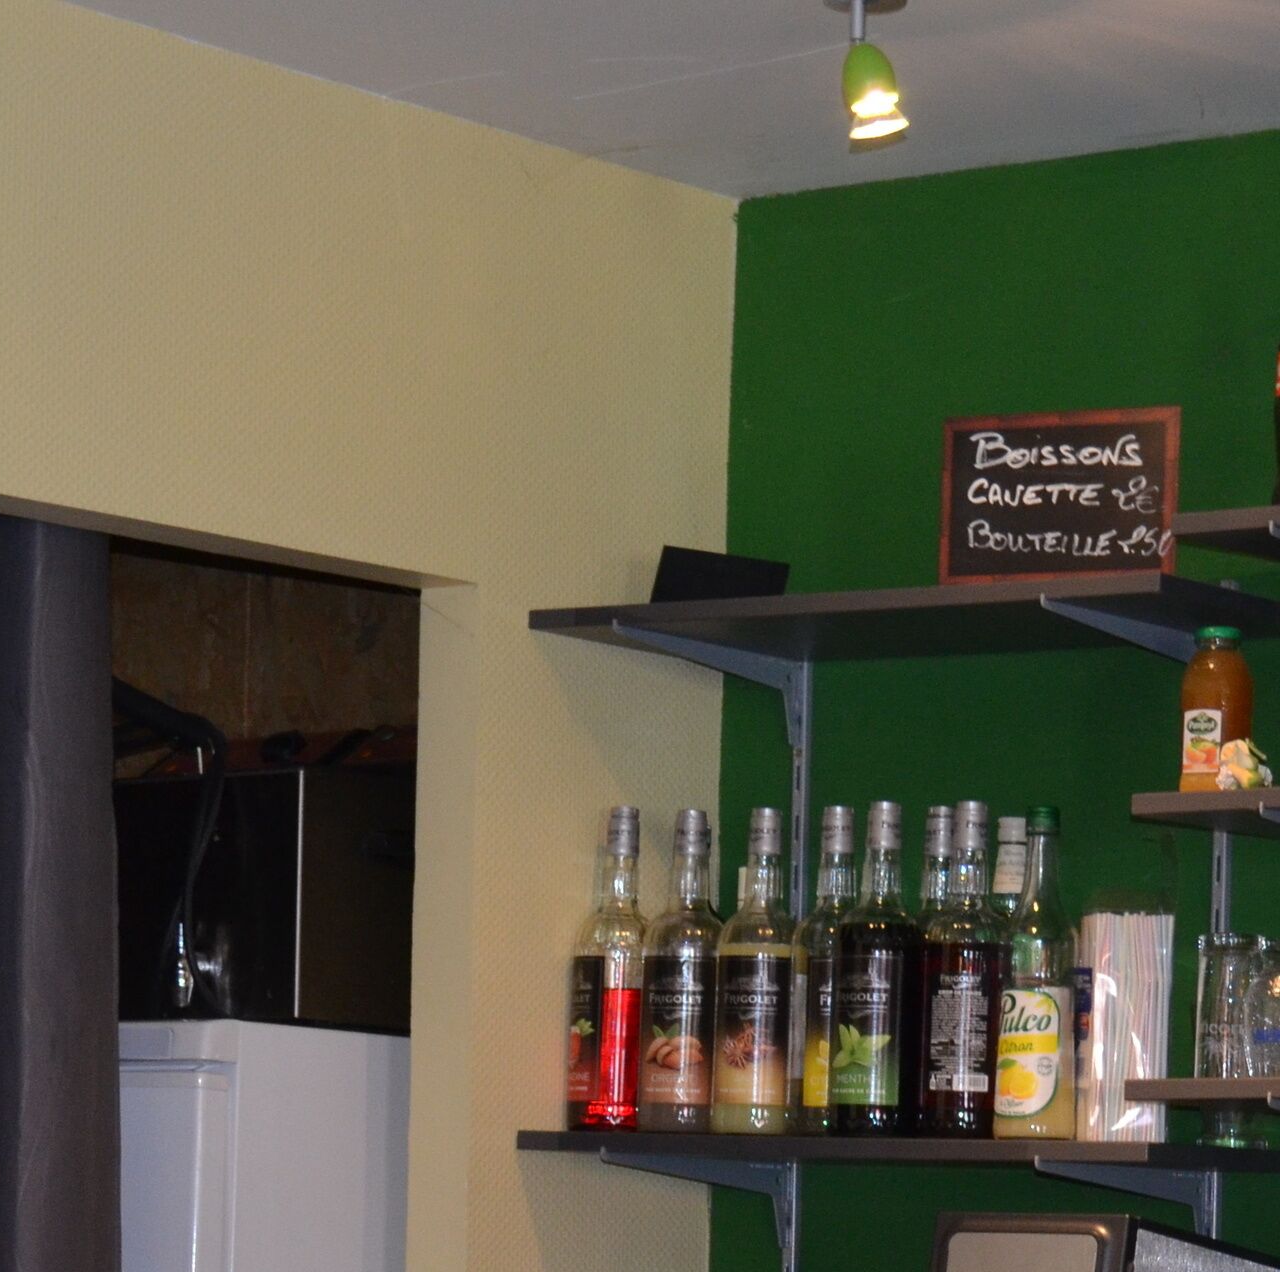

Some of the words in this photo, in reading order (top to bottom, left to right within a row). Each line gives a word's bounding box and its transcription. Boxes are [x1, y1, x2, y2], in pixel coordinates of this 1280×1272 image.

[967, 519, 1117, 557] BOUTEILLE
[723, 994, 778, 1005] FRIGOLET
[1000, 993, 1052, 1035] Pulco
